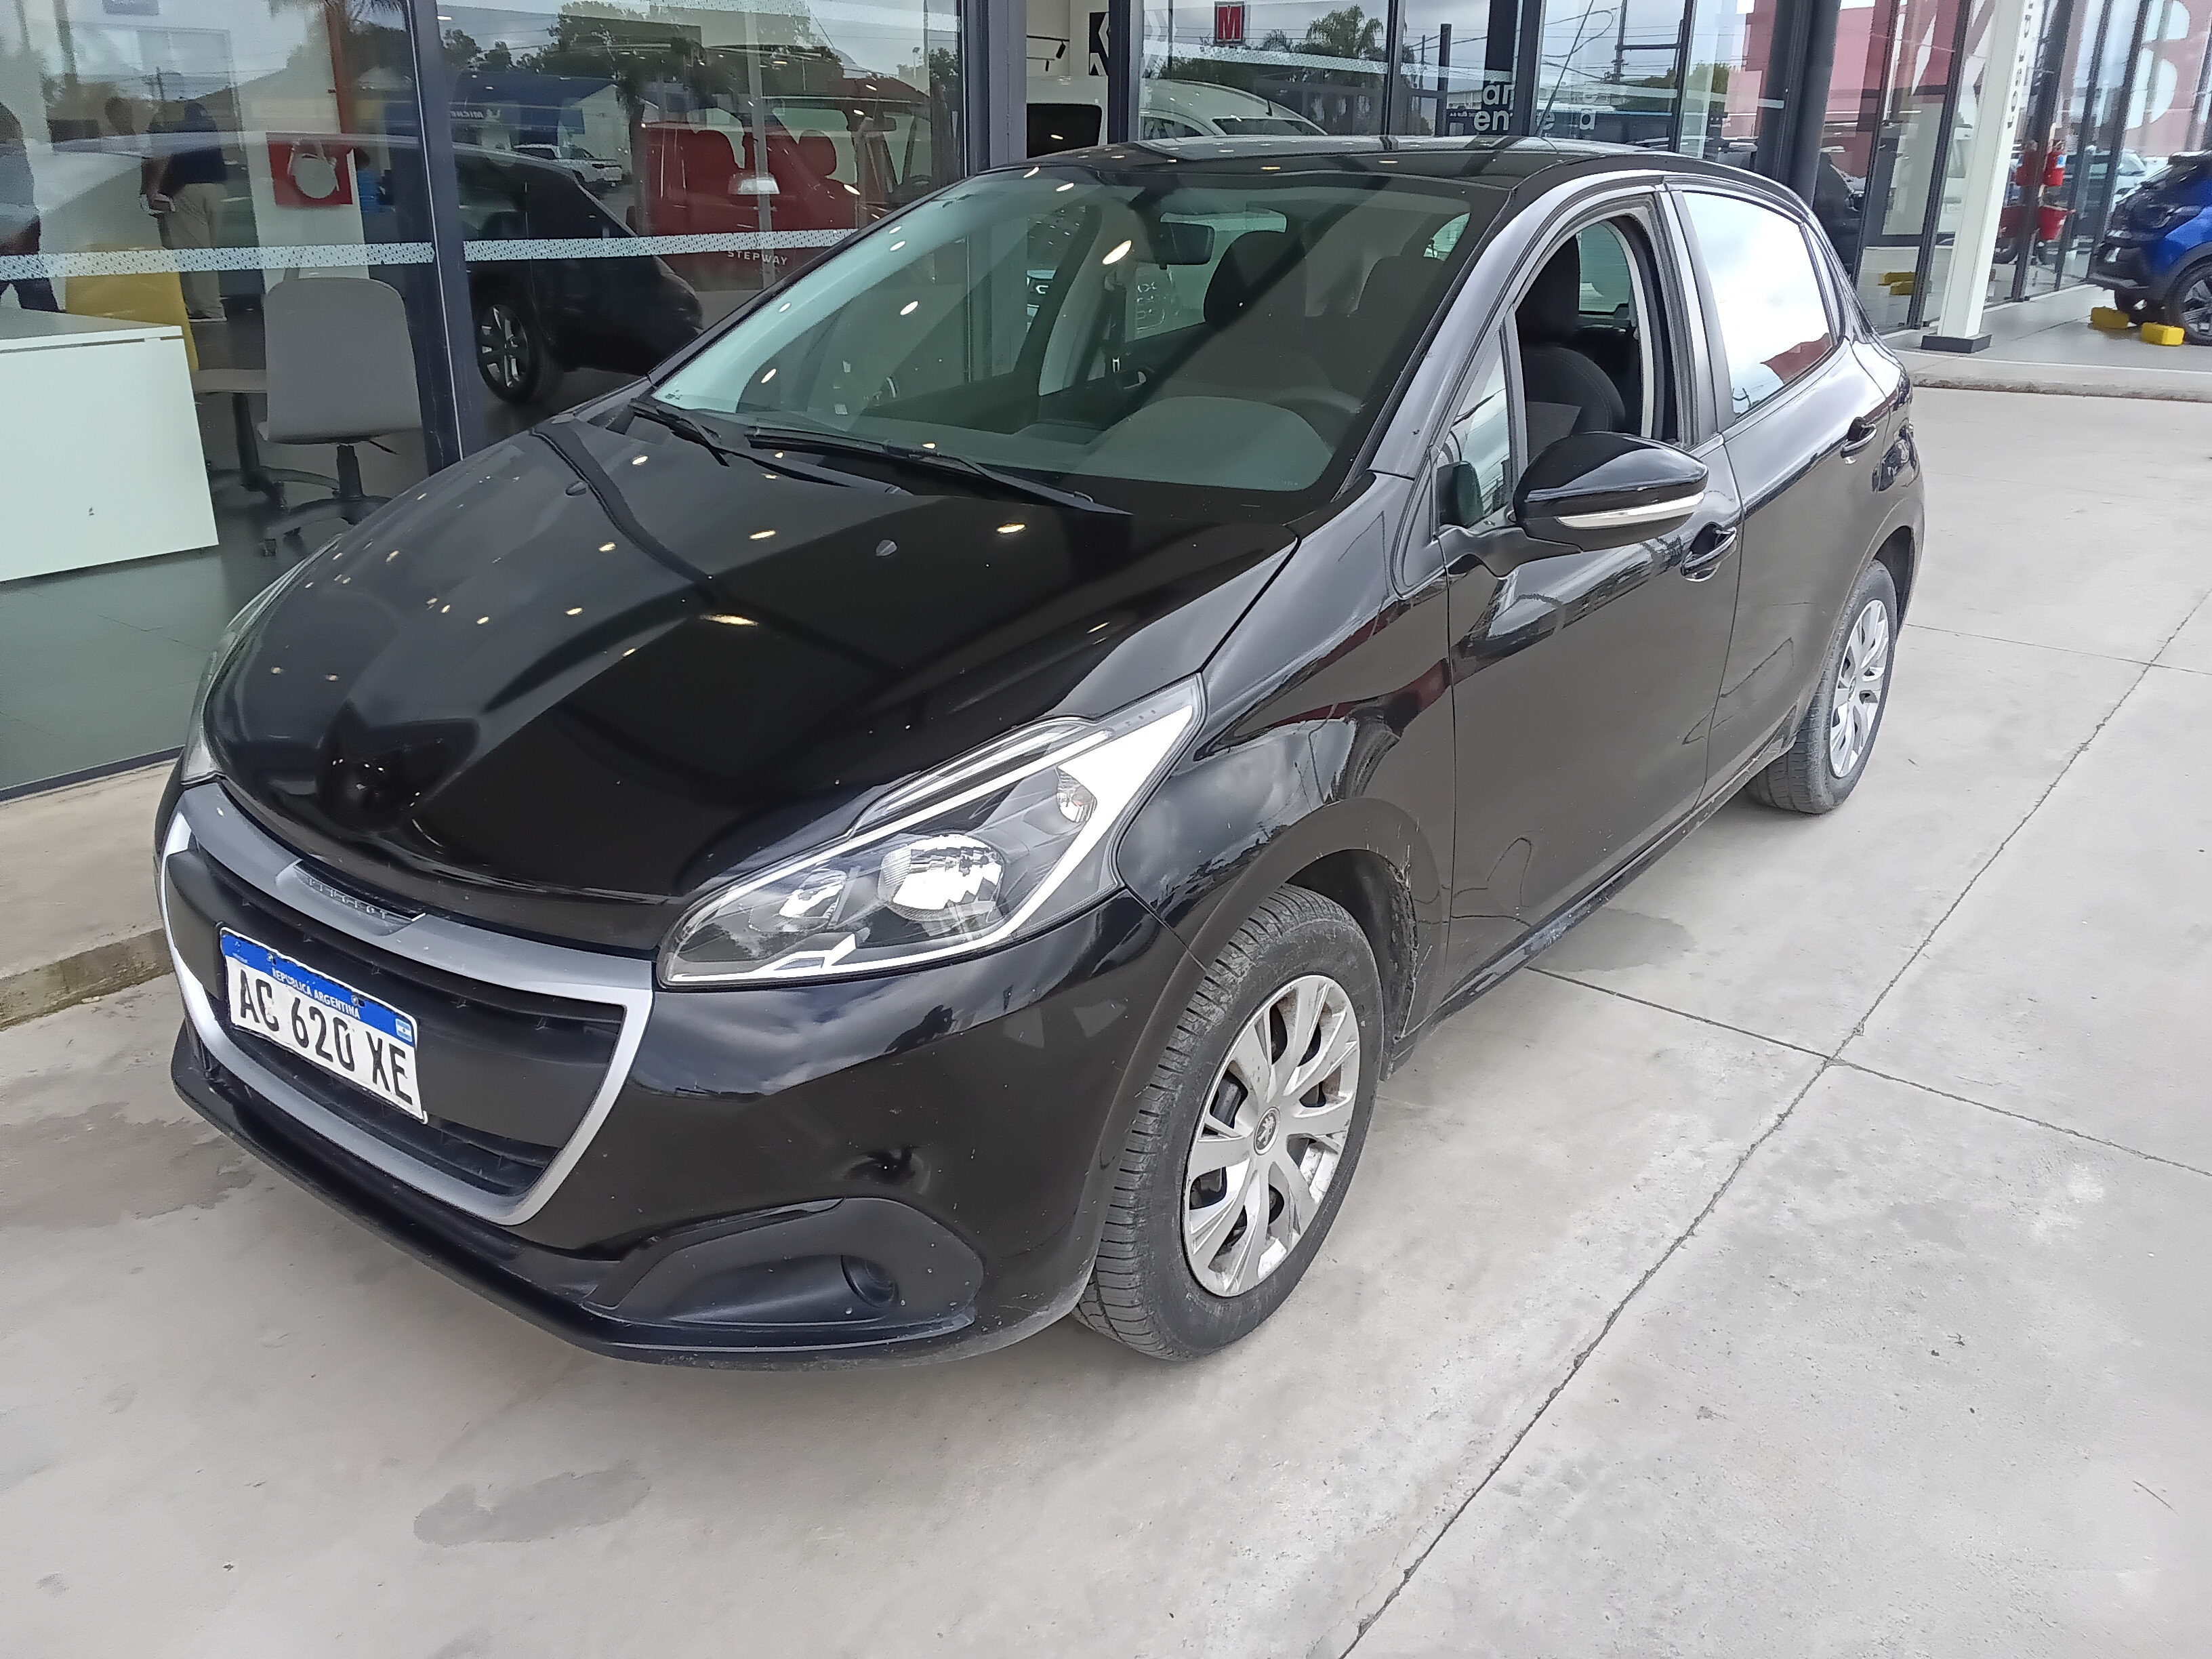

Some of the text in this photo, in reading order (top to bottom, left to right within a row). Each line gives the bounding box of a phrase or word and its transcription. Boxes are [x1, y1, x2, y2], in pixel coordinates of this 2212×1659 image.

[727, 251, 787, 265] STEPWAY
[314, 989, 361, 1020] ARGENTINA
[240, 968, 413, 1106] AC 620 XE
